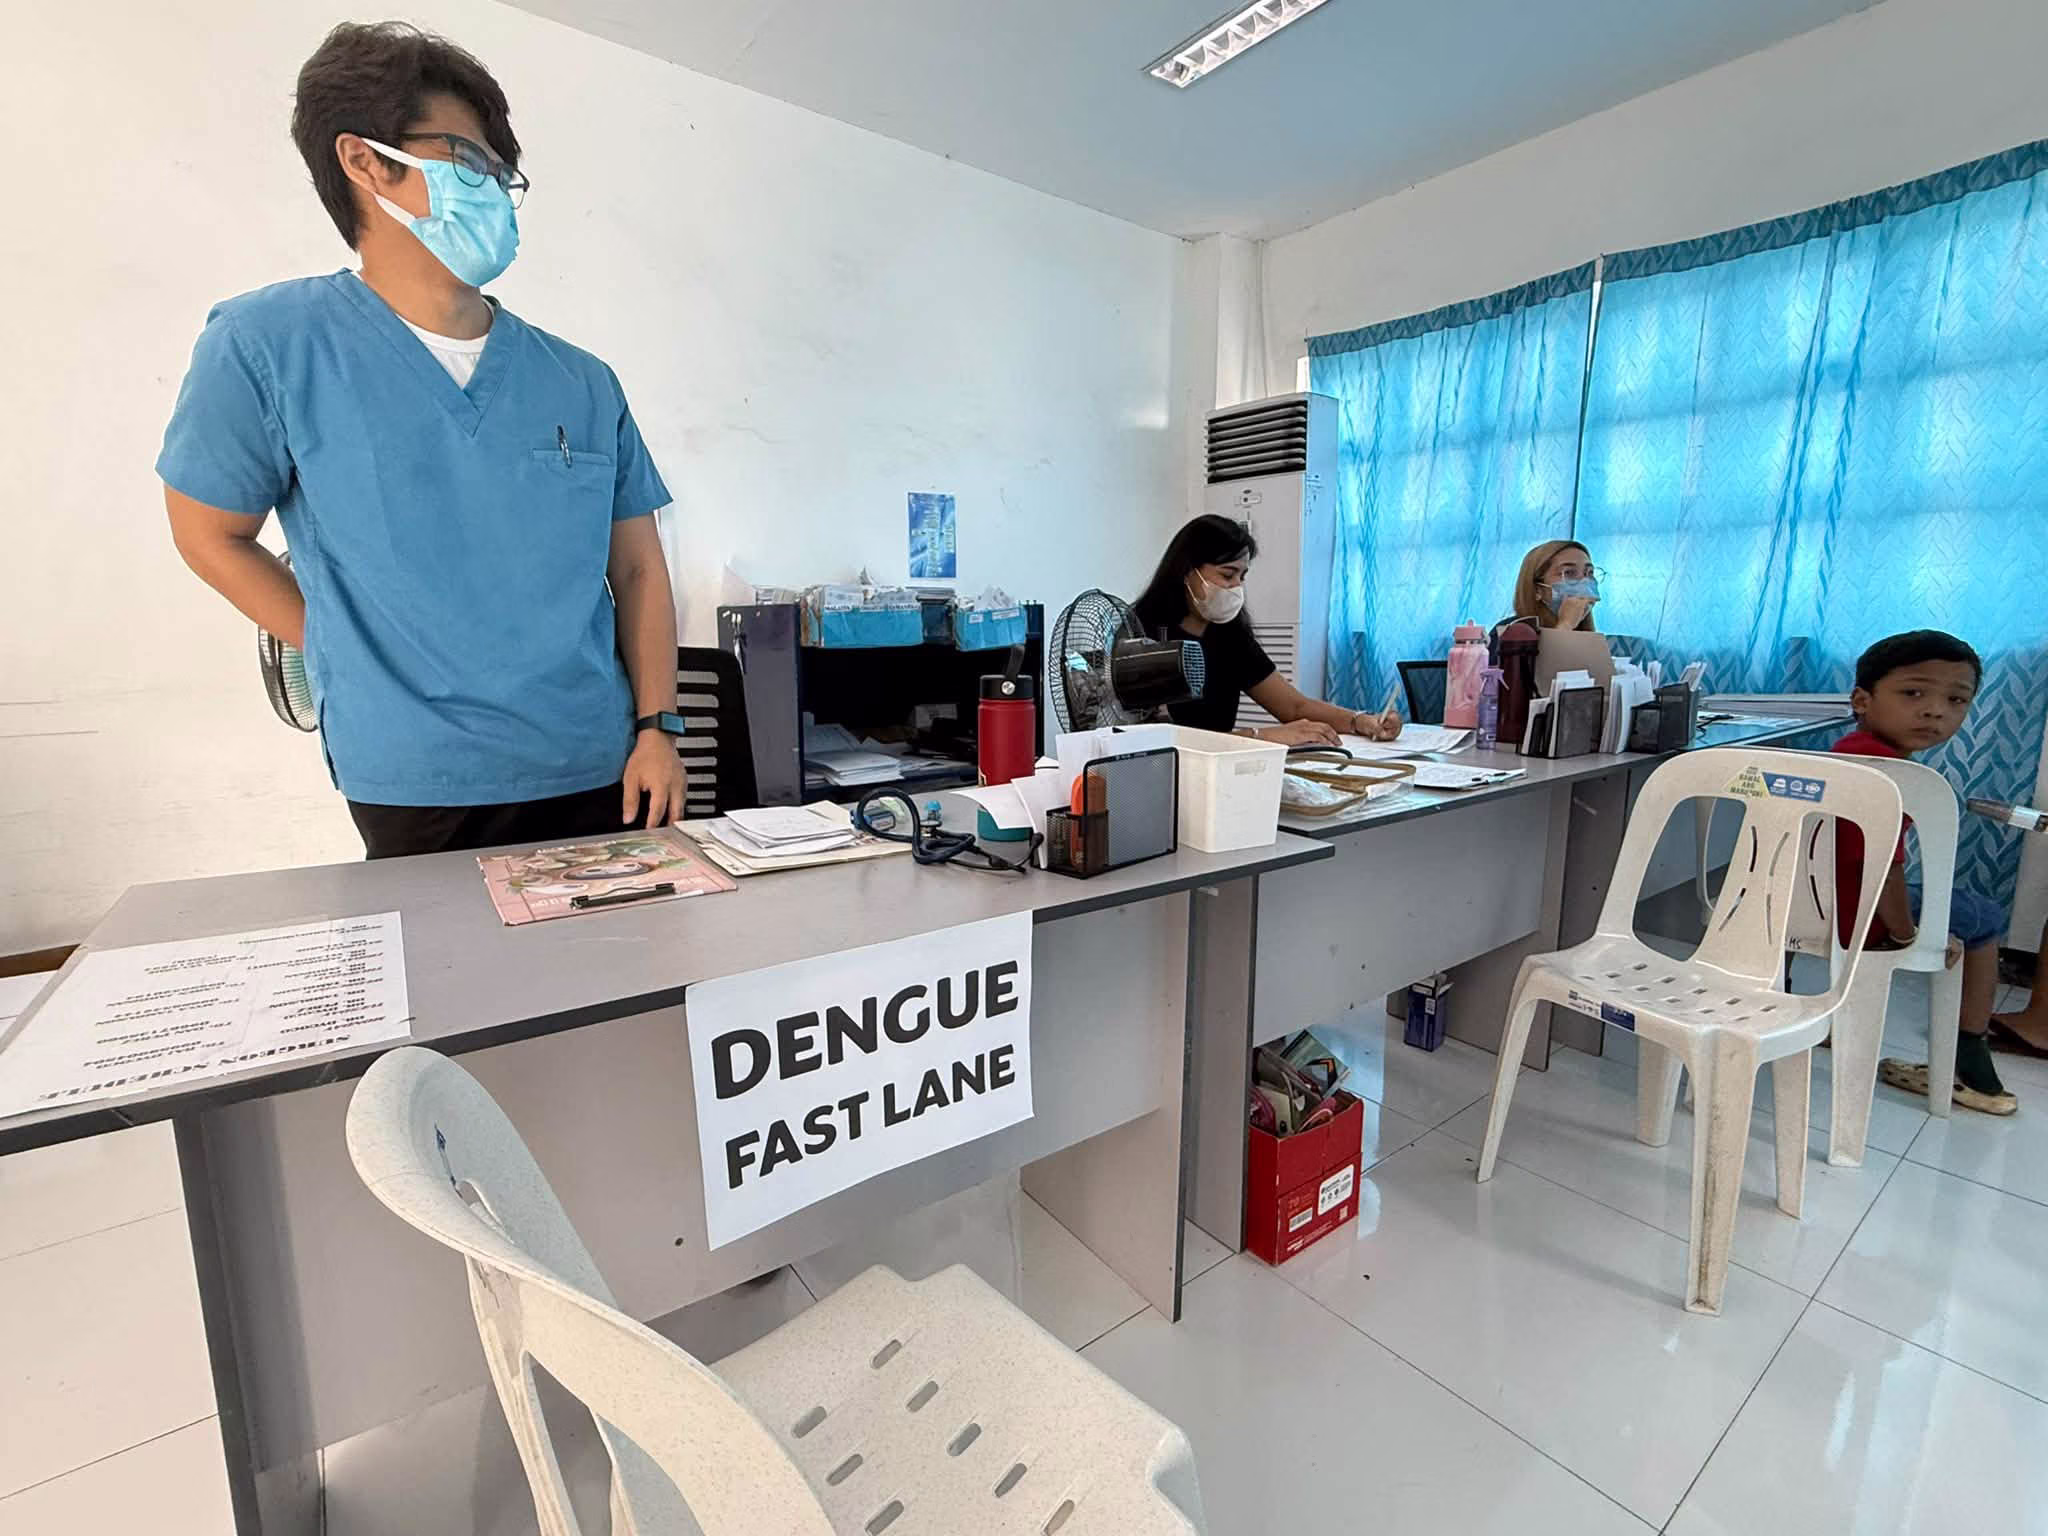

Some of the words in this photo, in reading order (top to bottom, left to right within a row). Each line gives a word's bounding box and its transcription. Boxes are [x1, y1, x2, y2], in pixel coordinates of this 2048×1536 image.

[711, 960, 1019, 1100] DENGUE
[725, 1091, 870, 1190] FAST
[882, 1044, 1016, 1128] LANE
